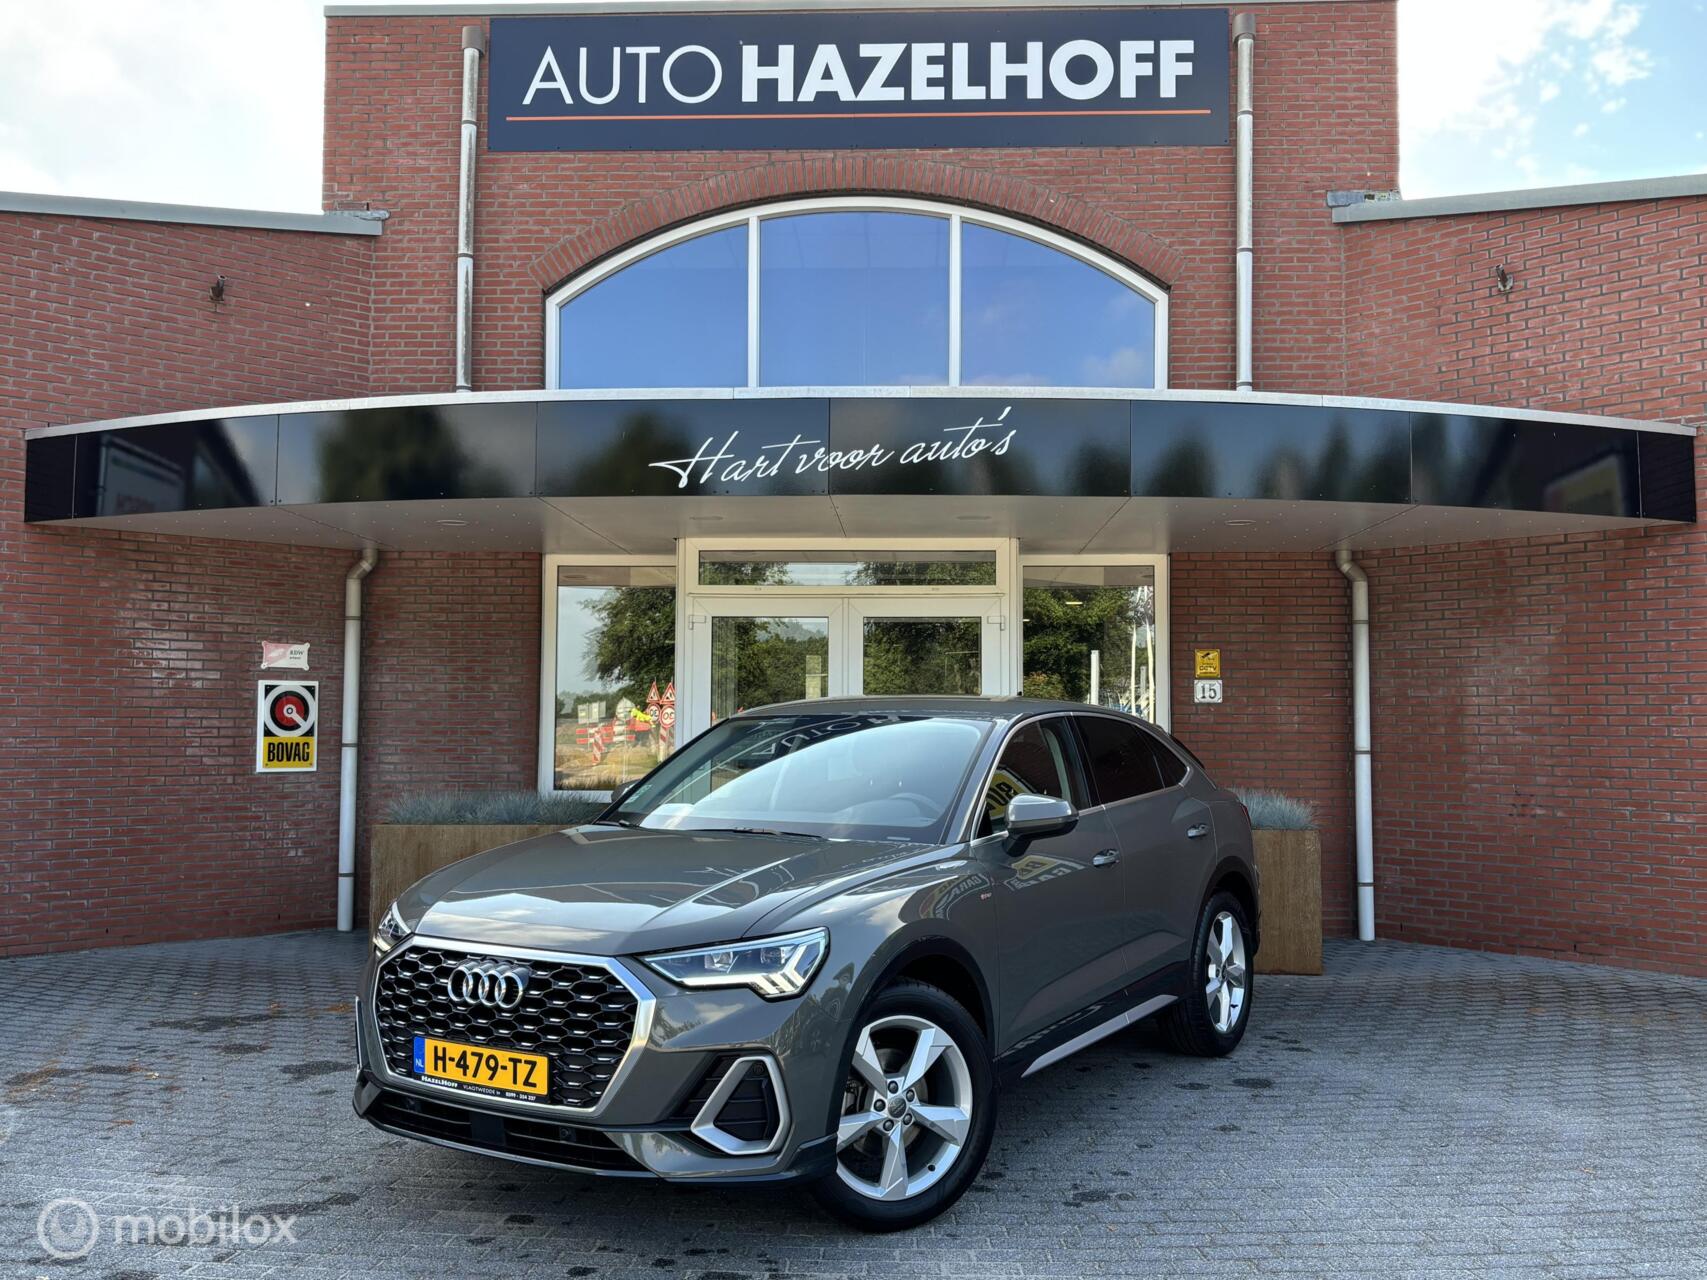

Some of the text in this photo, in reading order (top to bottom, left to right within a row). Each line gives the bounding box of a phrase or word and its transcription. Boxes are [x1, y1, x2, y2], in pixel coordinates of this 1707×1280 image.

[522, 39, 1194, 105] AUTO HAZELHOFF
[648, 406, 1017, 489] Hart voor auto's
[1201, 683, 1217, 699] 15
[267, 741, 310, 763] BOVAG
[415, 1057, 424, 1068] NL
[433, 1045, 538, 1088] H-479-TZ
